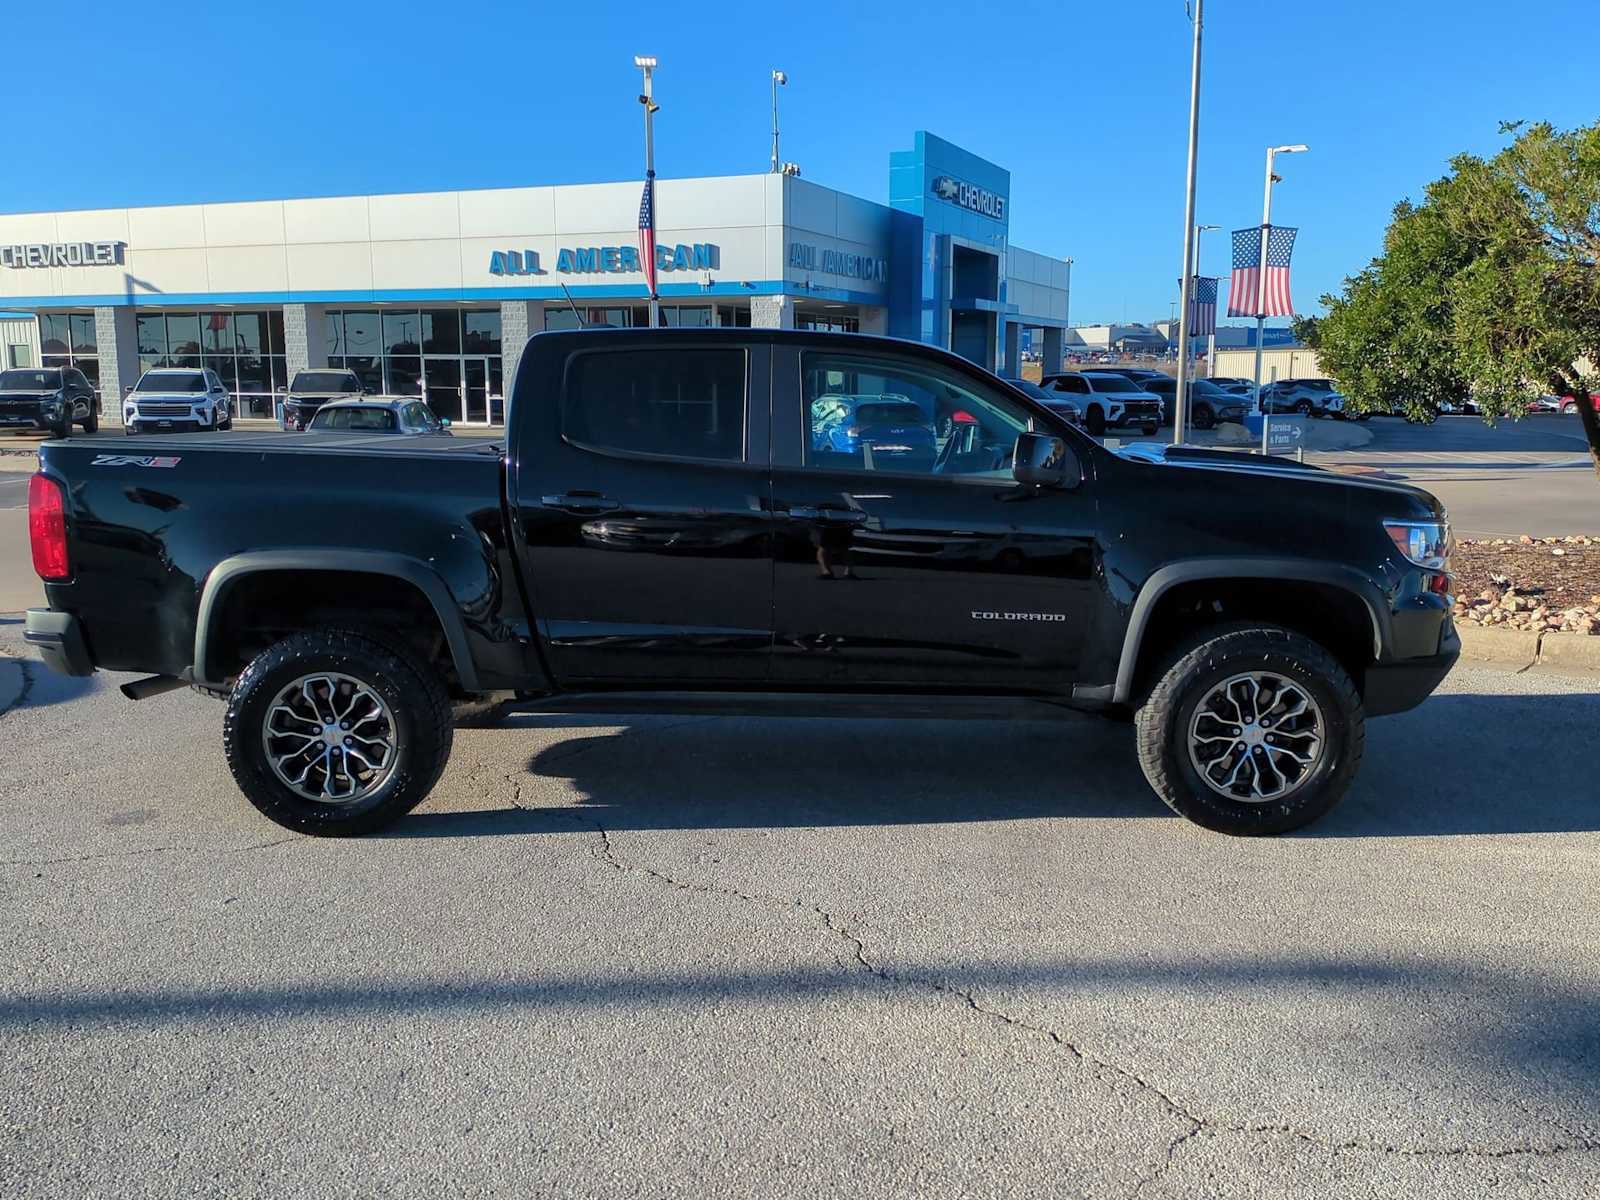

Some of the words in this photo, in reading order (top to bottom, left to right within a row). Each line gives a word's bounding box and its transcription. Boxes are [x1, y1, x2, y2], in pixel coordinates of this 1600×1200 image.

[960, 182, 1005, 219] CHEVROLET
[0, 241, 124, 267] CHEVROLET
[489, 250, 545, 275] ALL
[557, 243, 719, 272] AMERCAN
[791, 243, 816, 271] ALL
[823, 250, 888, 284] AMERICAN
[1270, 423, 1291, 432] Service
[1275, 435, 1289, 444] Parts
[90, 454, 182, 468] ZR2
[971, 611, 1066, 622] COLORADO
